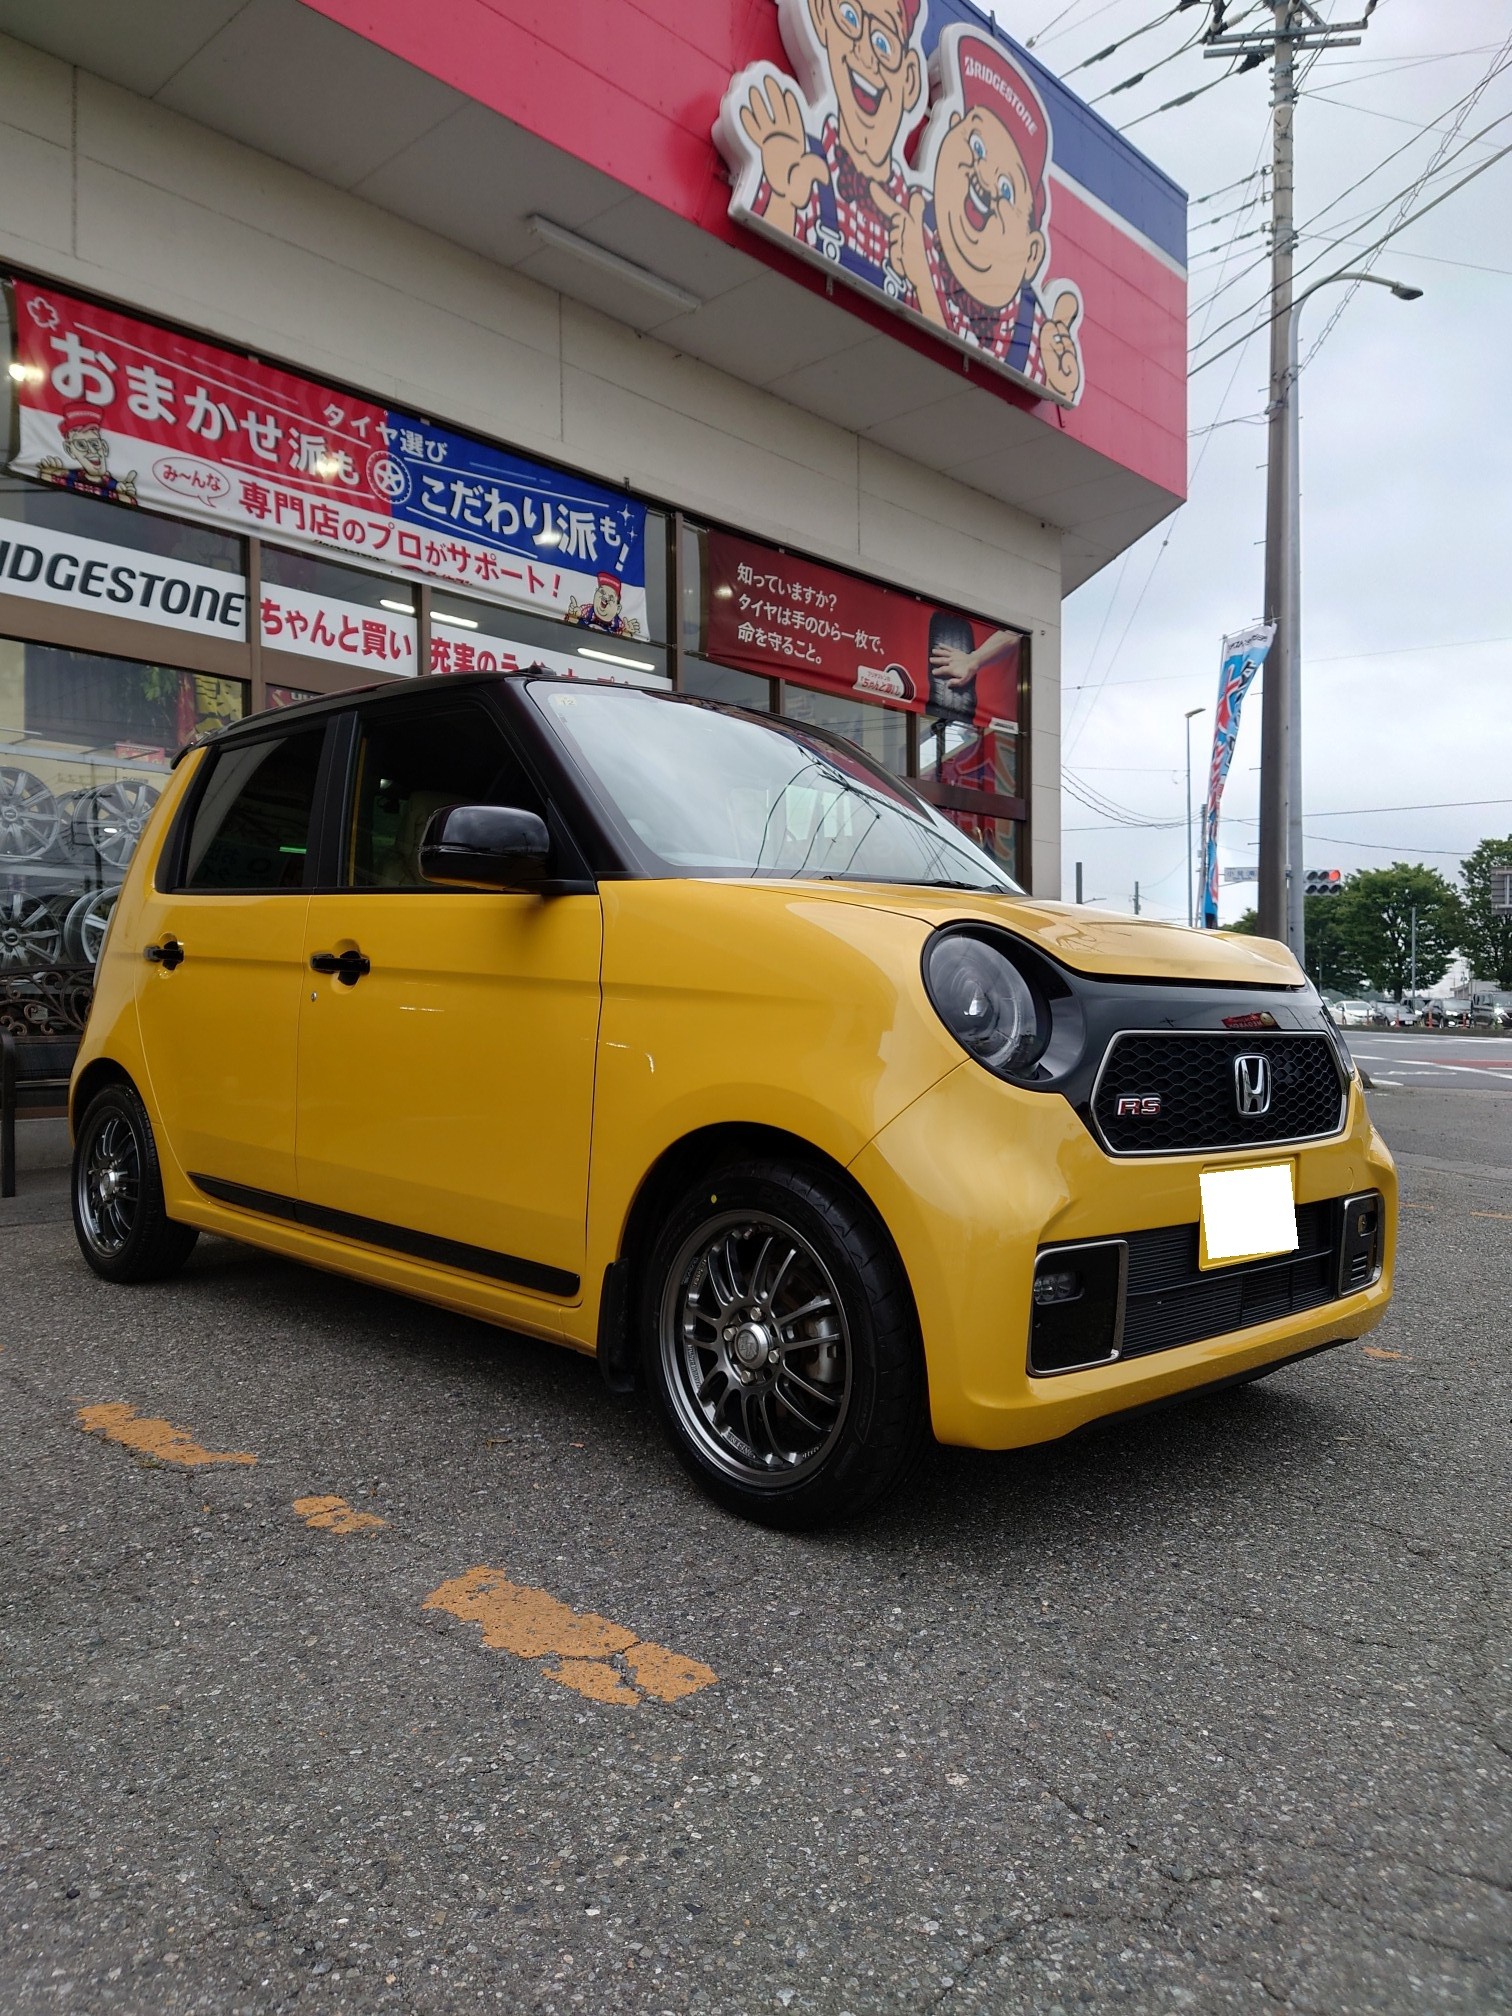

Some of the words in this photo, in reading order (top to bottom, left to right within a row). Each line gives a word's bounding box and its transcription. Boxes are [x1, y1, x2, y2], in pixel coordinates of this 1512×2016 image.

[965, 56, 1038, 136] BRIDGESTONE
[50, 331, 360, 485] おまかせ派も
[323, 403, 447, 463] タイヤ選び
[238, 479, 561, 598] 専門店のプロがサポート!
[737, 562, 838, 612] 知っていますか?
[260, 597, 412, 661] ちゃんと買い
[737, 621, 822, 665] 命を守ること。
[738, 593, 885, 656] タイヤは手のひら一枚で、
[1116, 1096, 1161, 1116] RS
